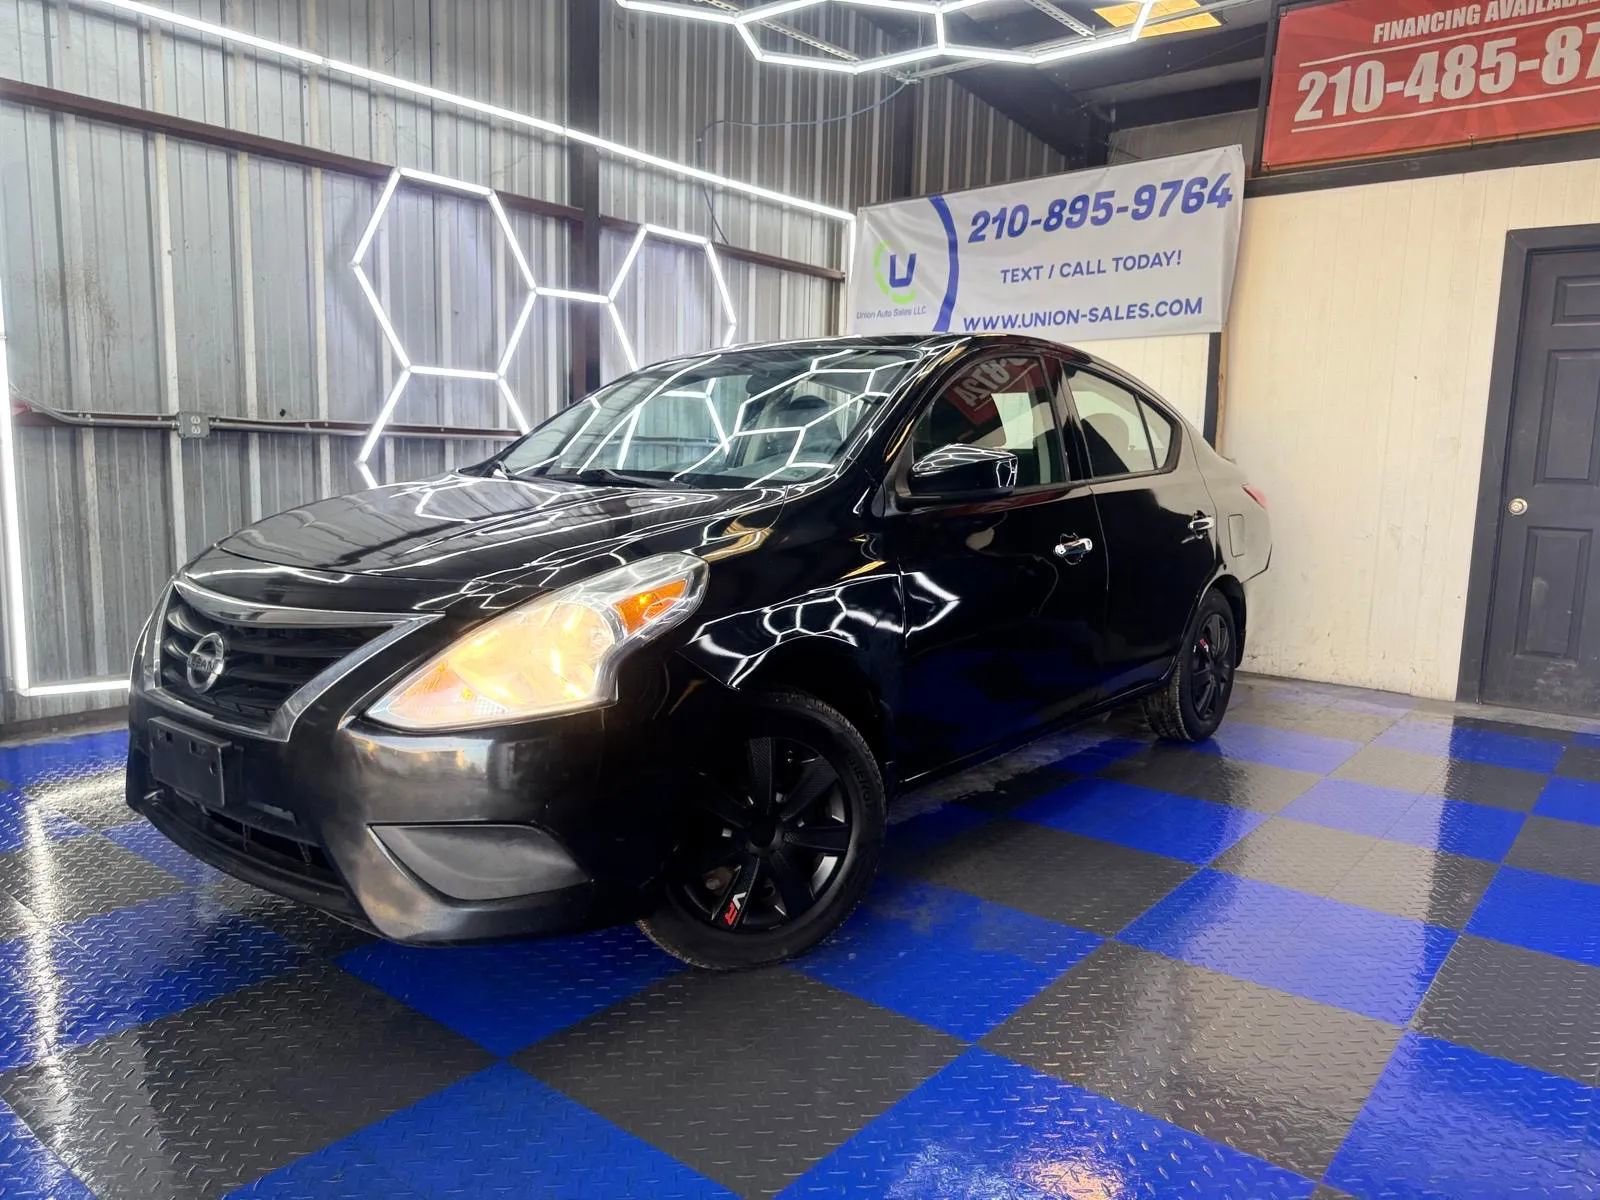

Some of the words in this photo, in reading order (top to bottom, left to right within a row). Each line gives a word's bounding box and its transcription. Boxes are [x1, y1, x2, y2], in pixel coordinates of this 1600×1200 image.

[1373, 6, 1480, 44] FINANCING
[967, 172, 1233, 243] 210-895-9764
[1001, 265, 1043, 284] TEXT
[1048, 262, 1056, 279] /
[1059, 259, 1107, 278] CALL
[1112, 250, 1182, 274] TODAY!
[856, 311, 876, 320] Union
[876, 309, 892, 319] Auto
[893, 307, 912, 317] Sales
[913, 304, 927, 315] LLC
[963, 297, 1203, 331] WWW.UNION-SALES.COM
